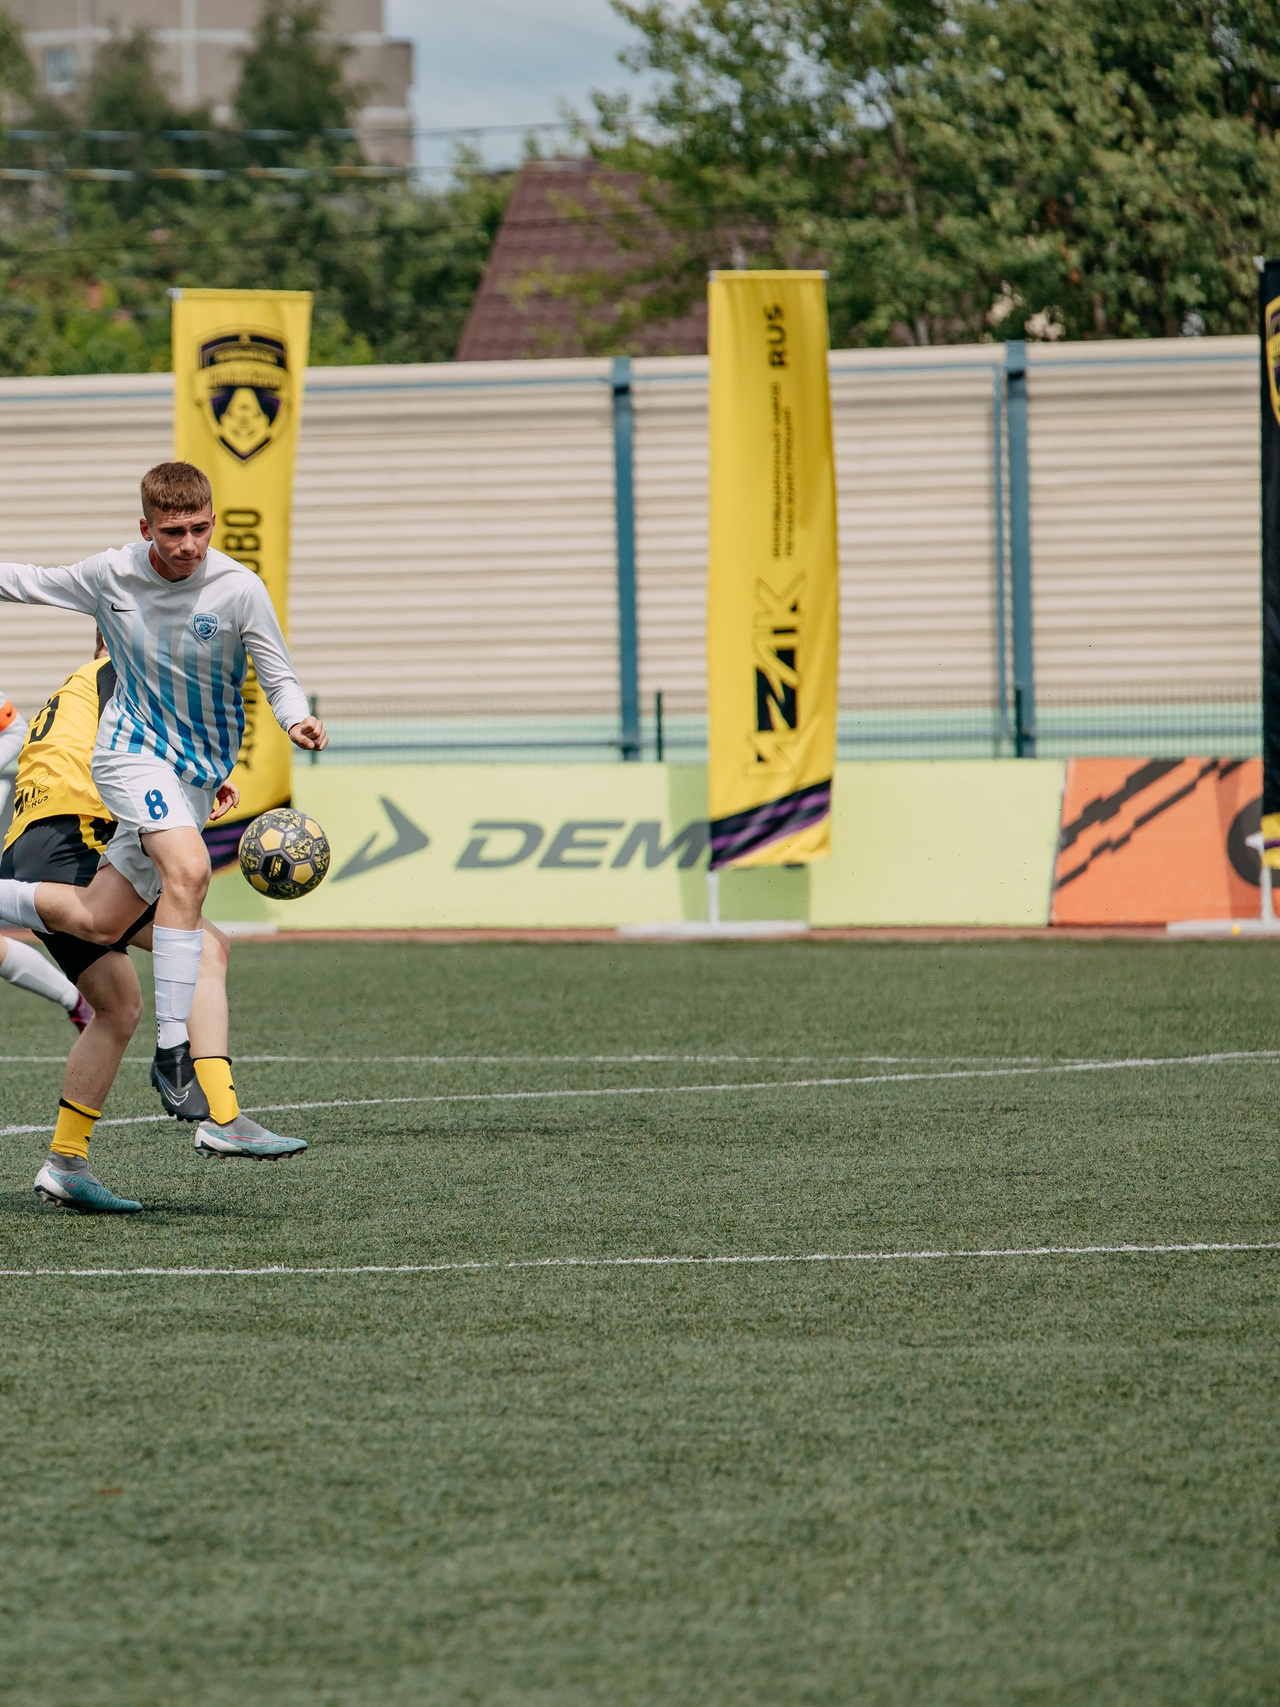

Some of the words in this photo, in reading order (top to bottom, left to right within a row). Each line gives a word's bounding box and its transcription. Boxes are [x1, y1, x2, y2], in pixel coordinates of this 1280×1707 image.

[766, 302, 789, 369] RUS
[144, 789, 169, 820] 8
[454, 820, 712, 869] DEM
